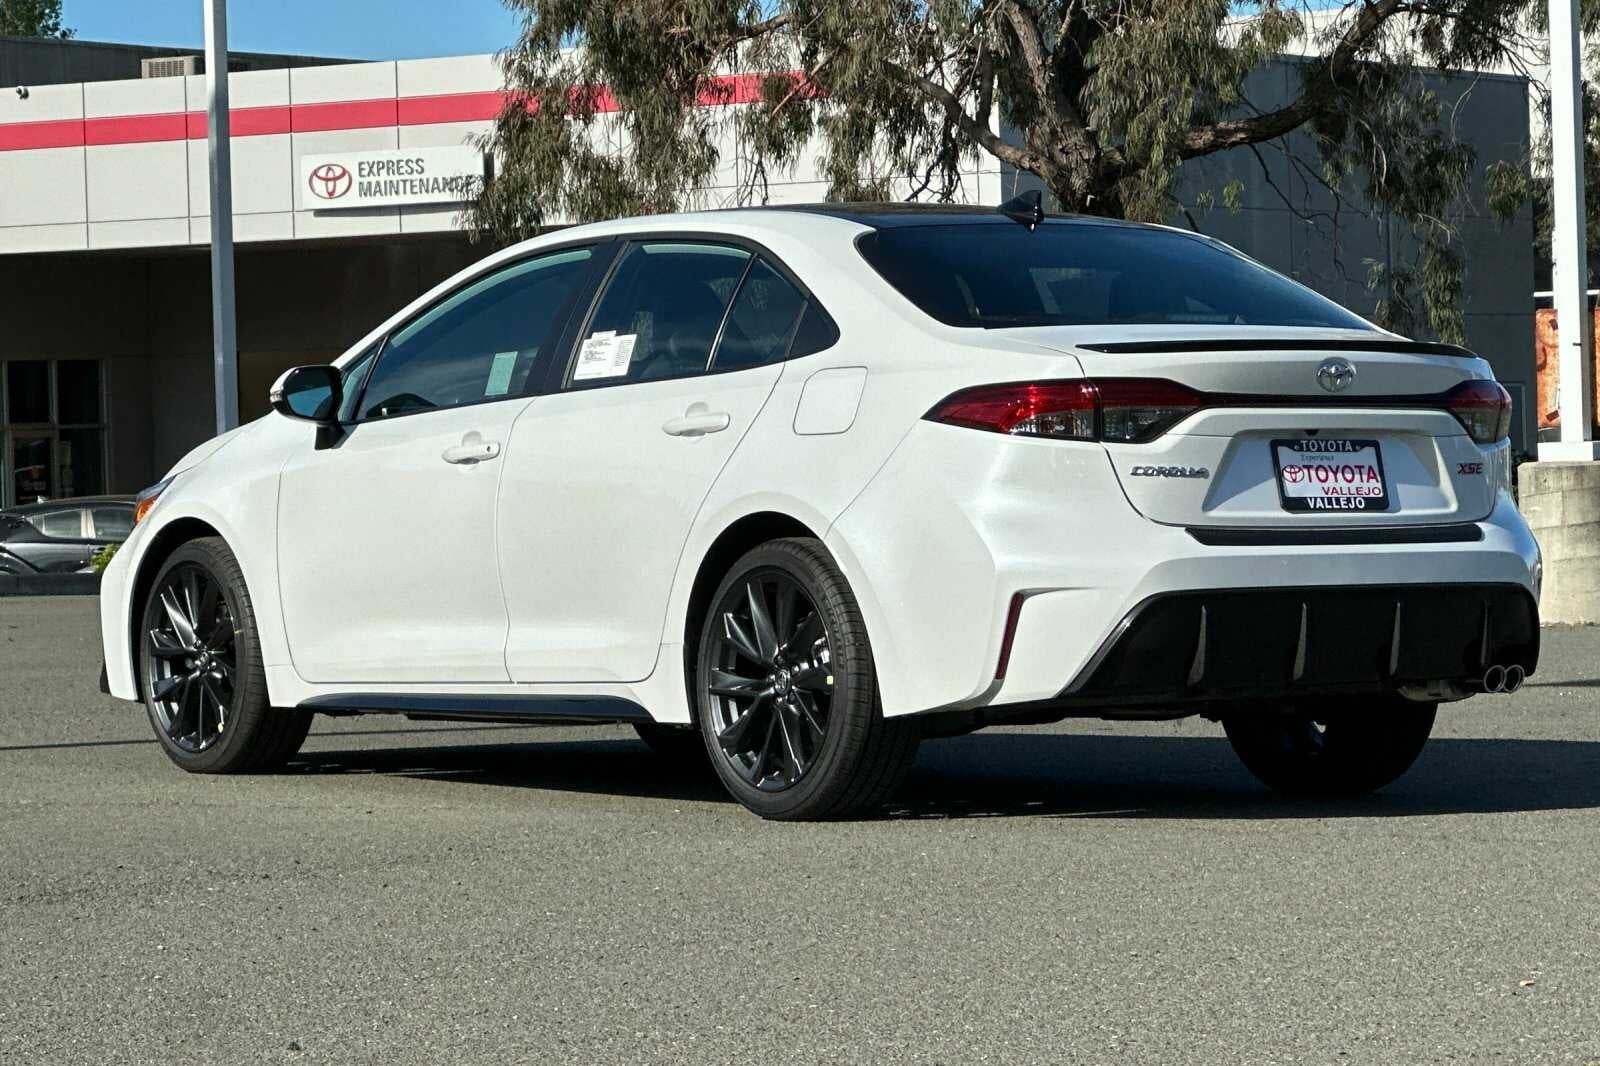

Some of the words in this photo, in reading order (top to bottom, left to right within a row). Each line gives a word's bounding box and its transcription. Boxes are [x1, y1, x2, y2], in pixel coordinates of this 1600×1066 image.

[358, 158, 425, 177] EXPRESS
[1301, 440, 1353, 452] TOYOTA
[1130, 466, 1210, 479] COROLLA
[1302, 464, 1380, 483] TOYOTA
[1457, 462, 1483, 475] XSE
[1321, 486, 1382, 496] VALLEJO
[1306, 497, 1365, 509] VALLEJO
